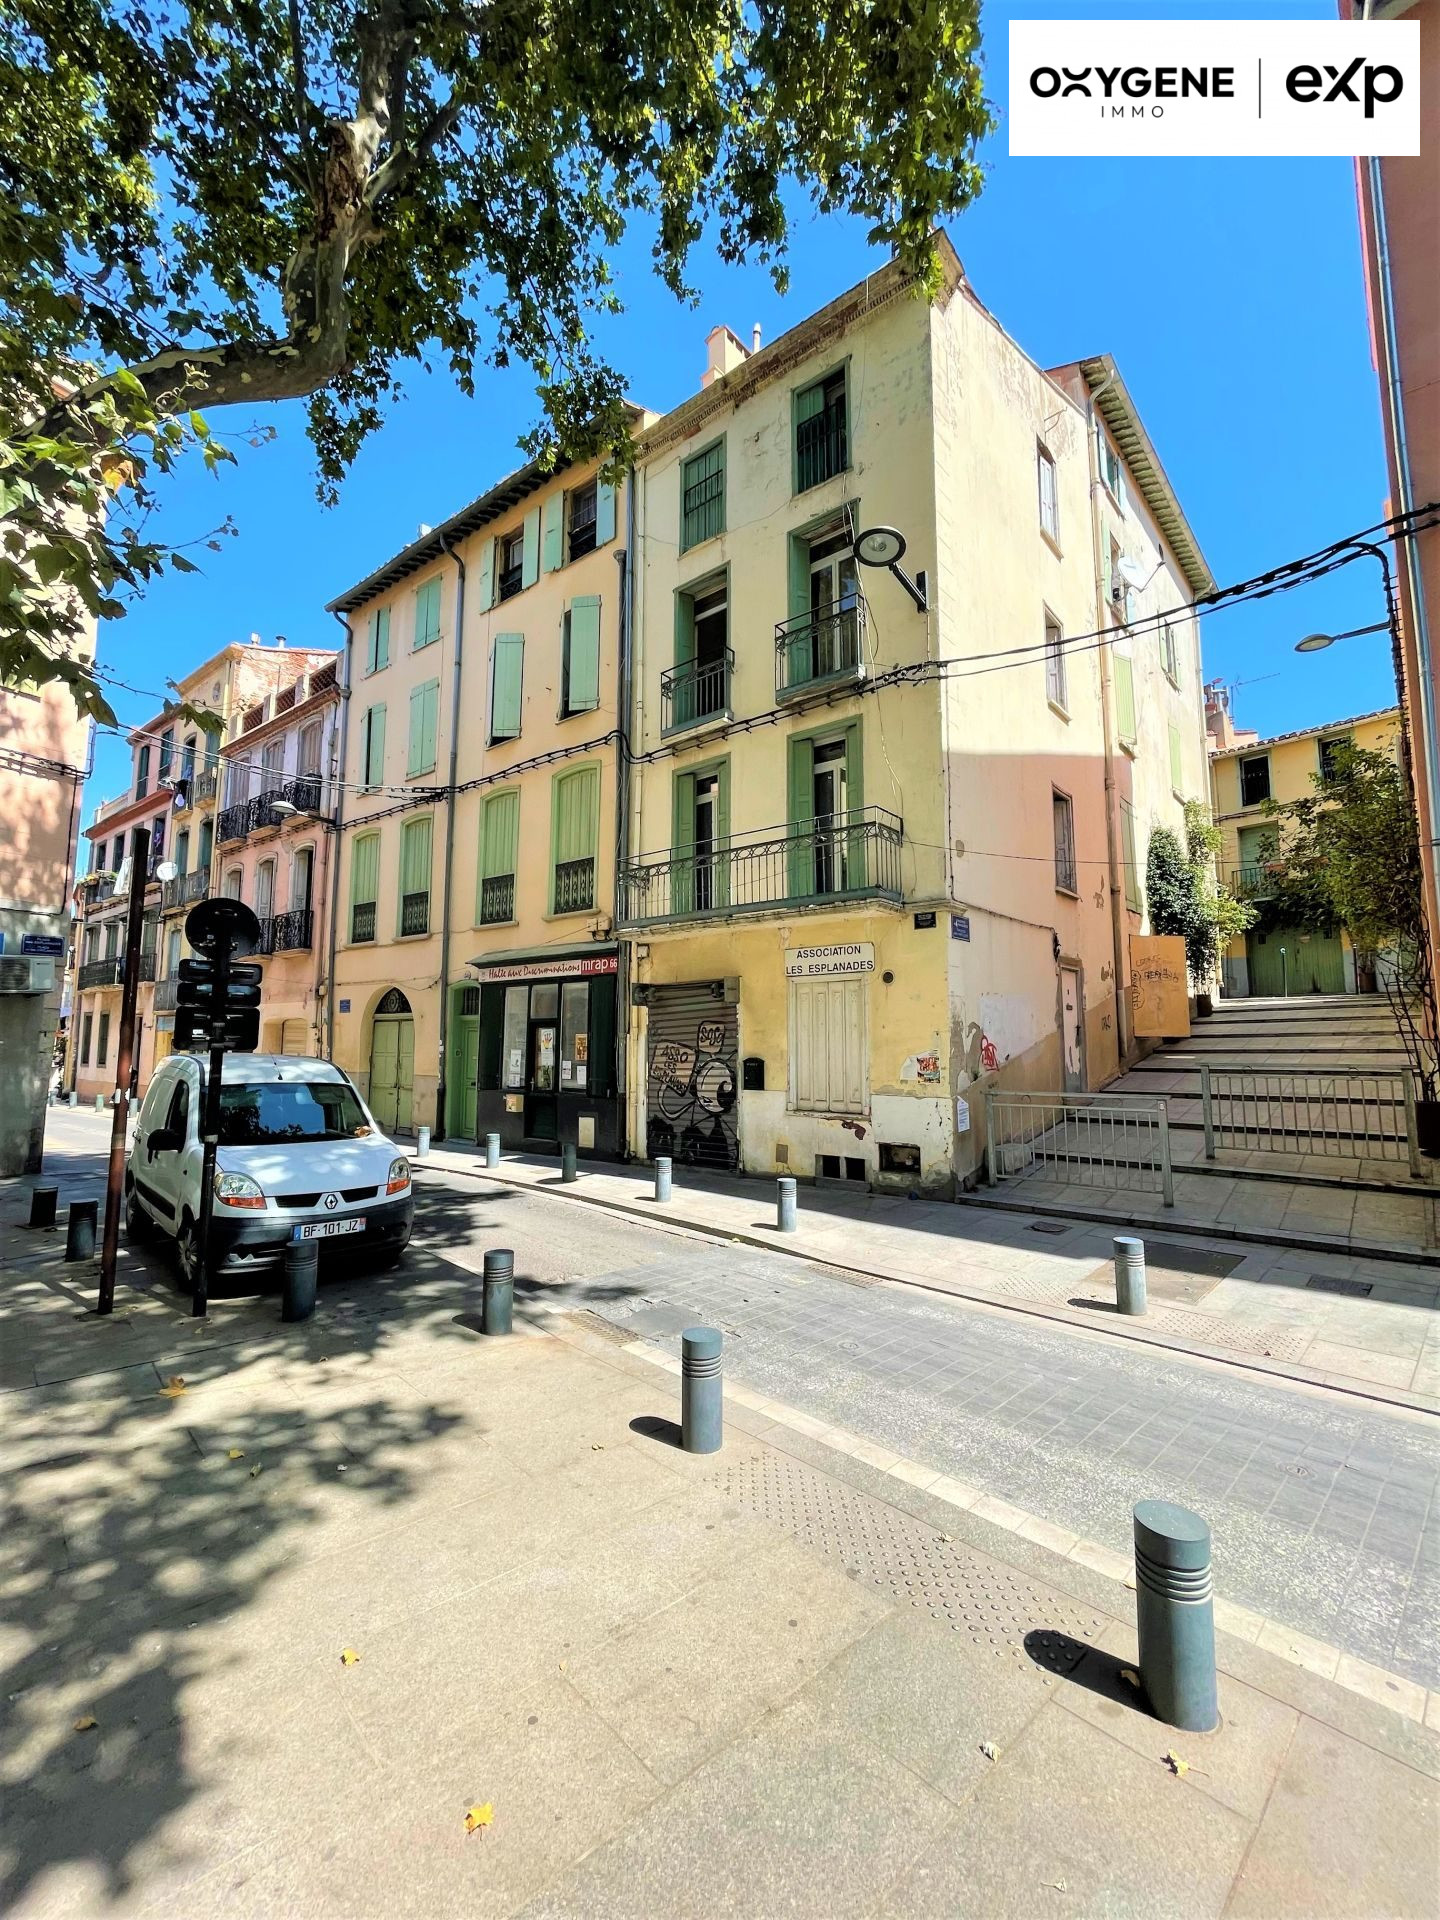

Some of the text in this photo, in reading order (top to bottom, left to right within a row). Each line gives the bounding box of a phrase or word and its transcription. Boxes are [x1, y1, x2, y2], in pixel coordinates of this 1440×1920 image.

[796, 945, 861, 959] ASSOCIATION
[488, 958, 618, 979] Halte aux Discriminations mrap 66
[786, 960, 874, 975] LES ESPLANADES
[303, 1220, 359, 1238] BF-101-JZ
